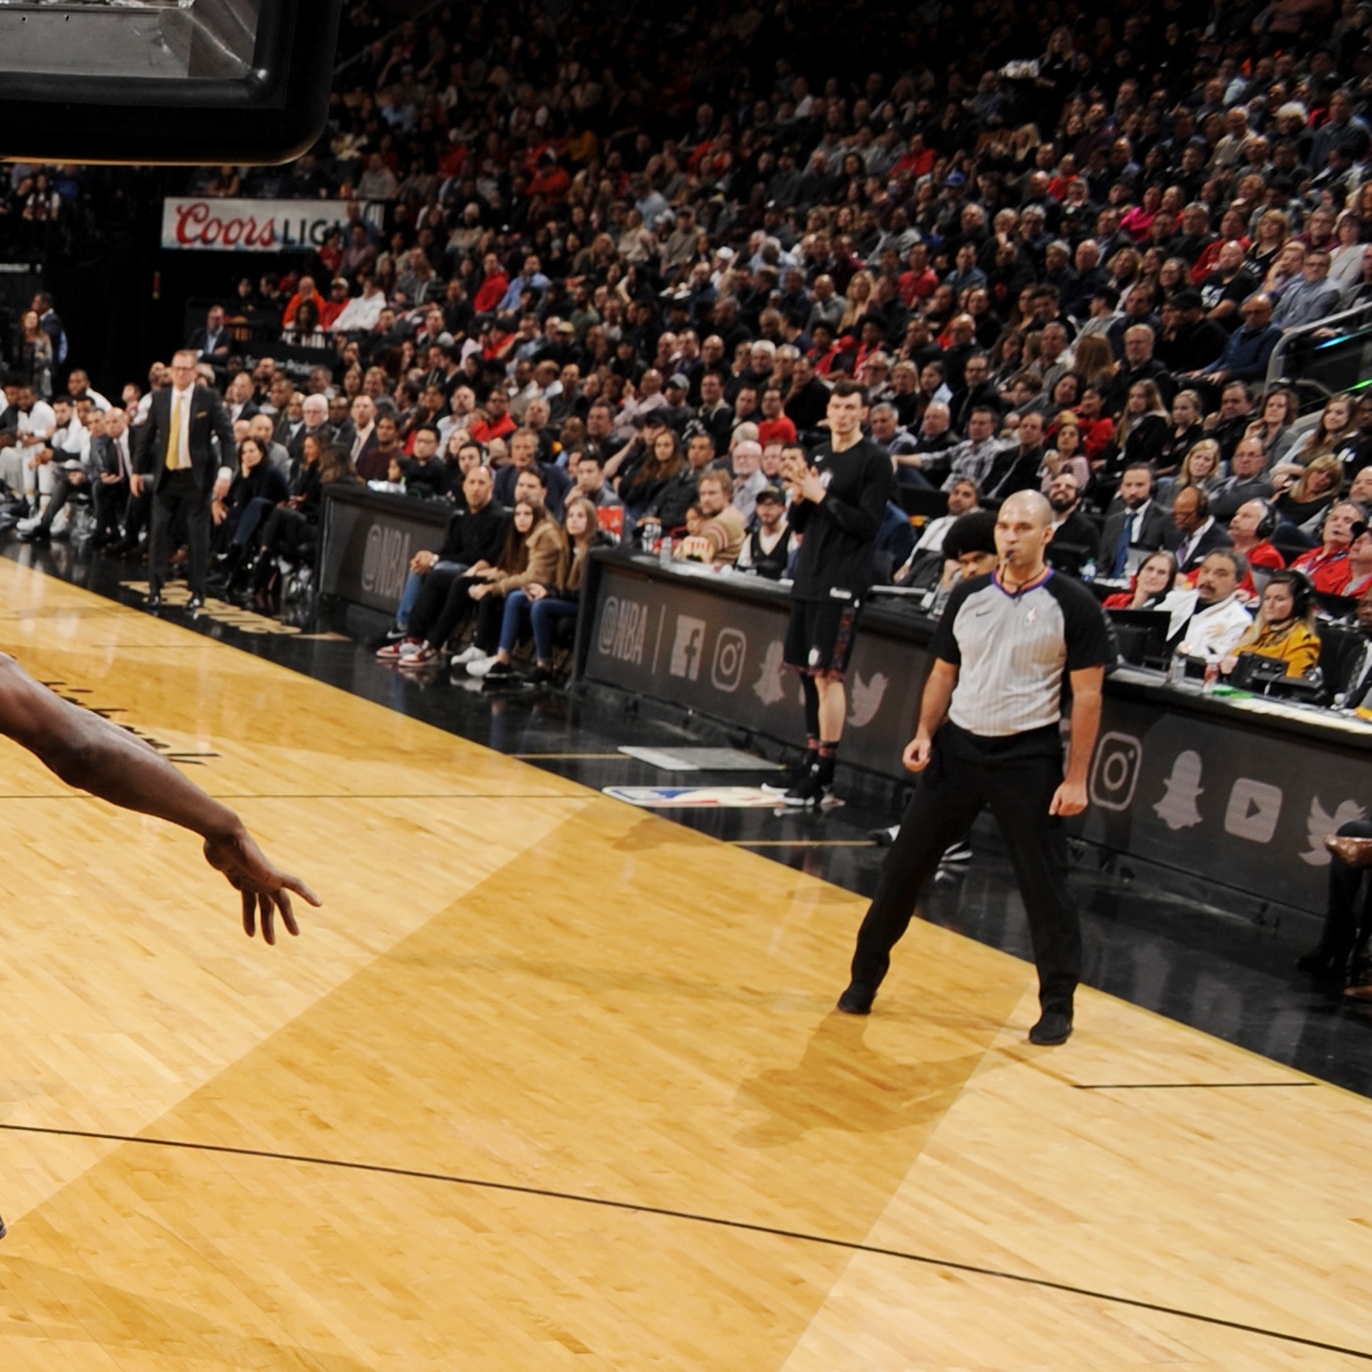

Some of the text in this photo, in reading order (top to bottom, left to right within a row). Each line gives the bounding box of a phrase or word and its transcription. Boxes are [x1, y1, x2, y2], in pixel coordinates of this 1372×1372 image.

[175, 202, 341, 247] Coors LIG
[598, 596, 649, 666] @NBA
